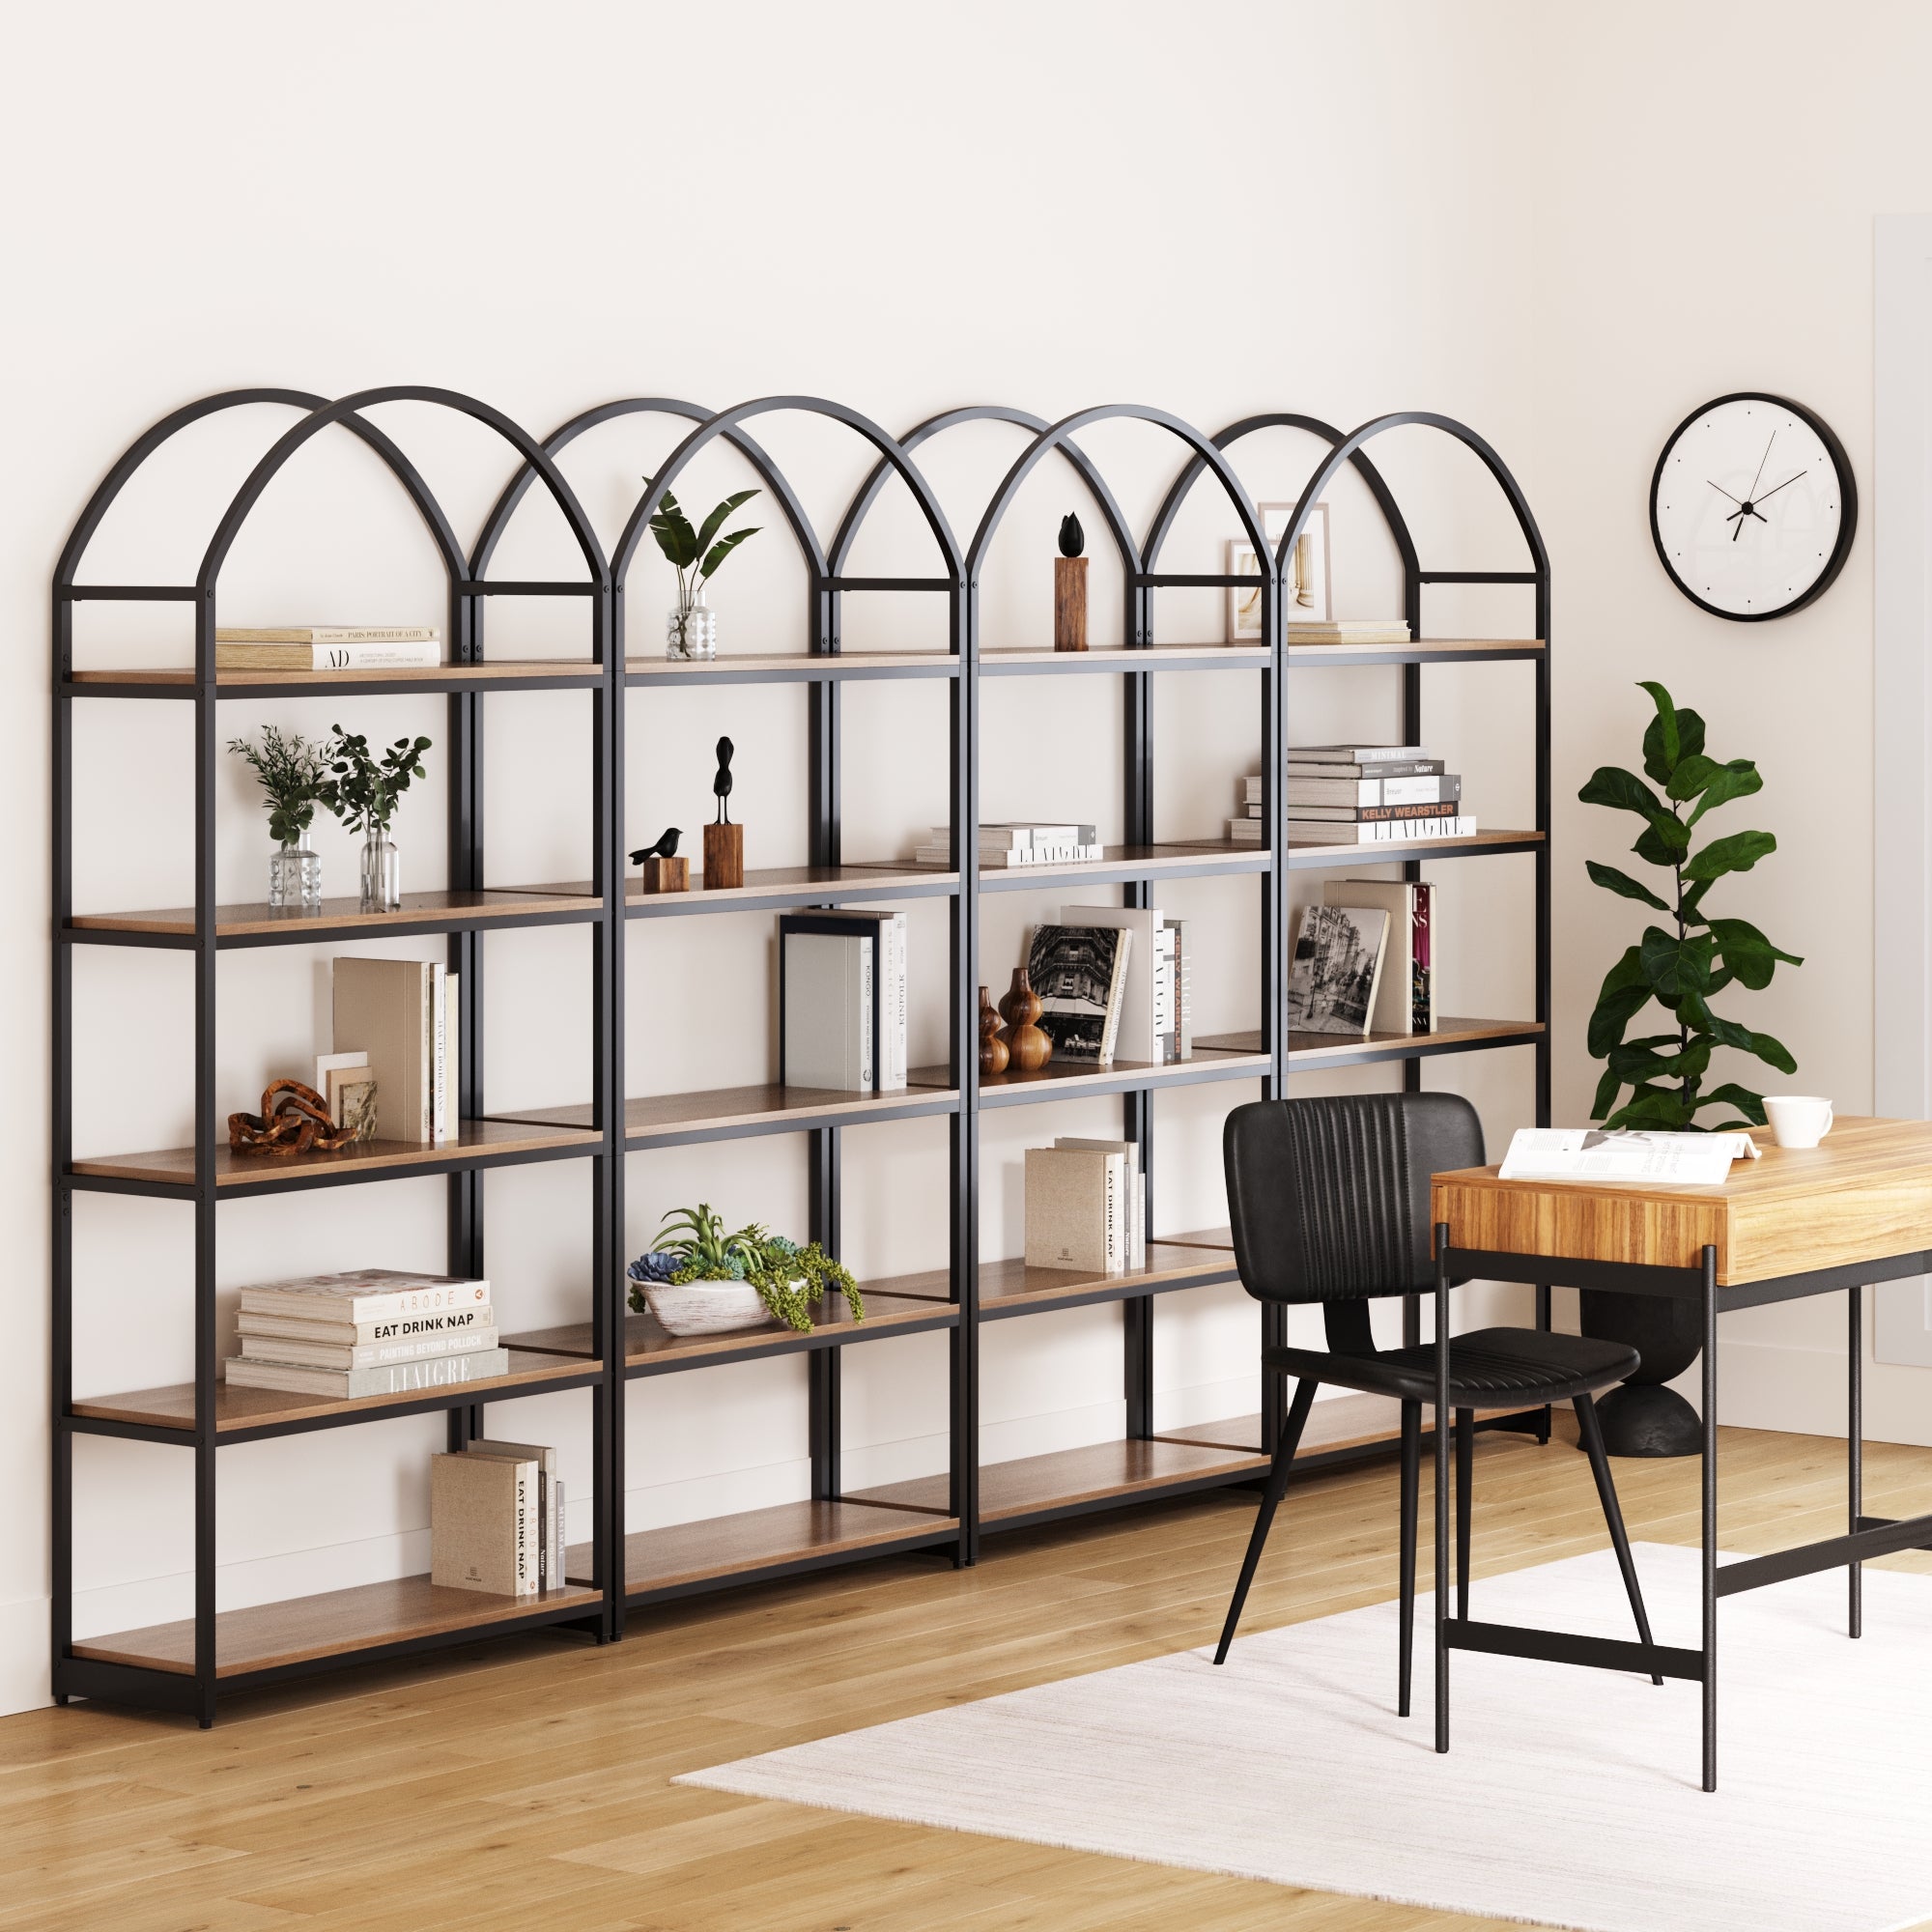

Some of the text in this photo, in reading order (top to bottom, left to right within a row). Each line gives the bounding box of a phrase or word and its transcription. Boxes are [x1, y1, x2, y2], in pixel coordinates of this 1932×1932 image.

[325, 650, 350, 668] AD
[1372, 750, 1406, 760] MINIMAL
[1414, 764, 1434, 773] Nature
[1362, 804, 1454, 820] KELLY WEARSTLER
[400, 1291, 455, 1312] ABODE
[374, 1324, 399, 1339] EAT
[403, 1318, 443, 1335] DRINK
[447, 1313, 474, 1328] NAP
[380, 1344, 415, 1360] PAINTING
[416, 1340, 446, 1355] BEYOND
[447, 1334, 482, 1350] POLLOCK
[389, 1357, 470, 1394] LIAIGRE
